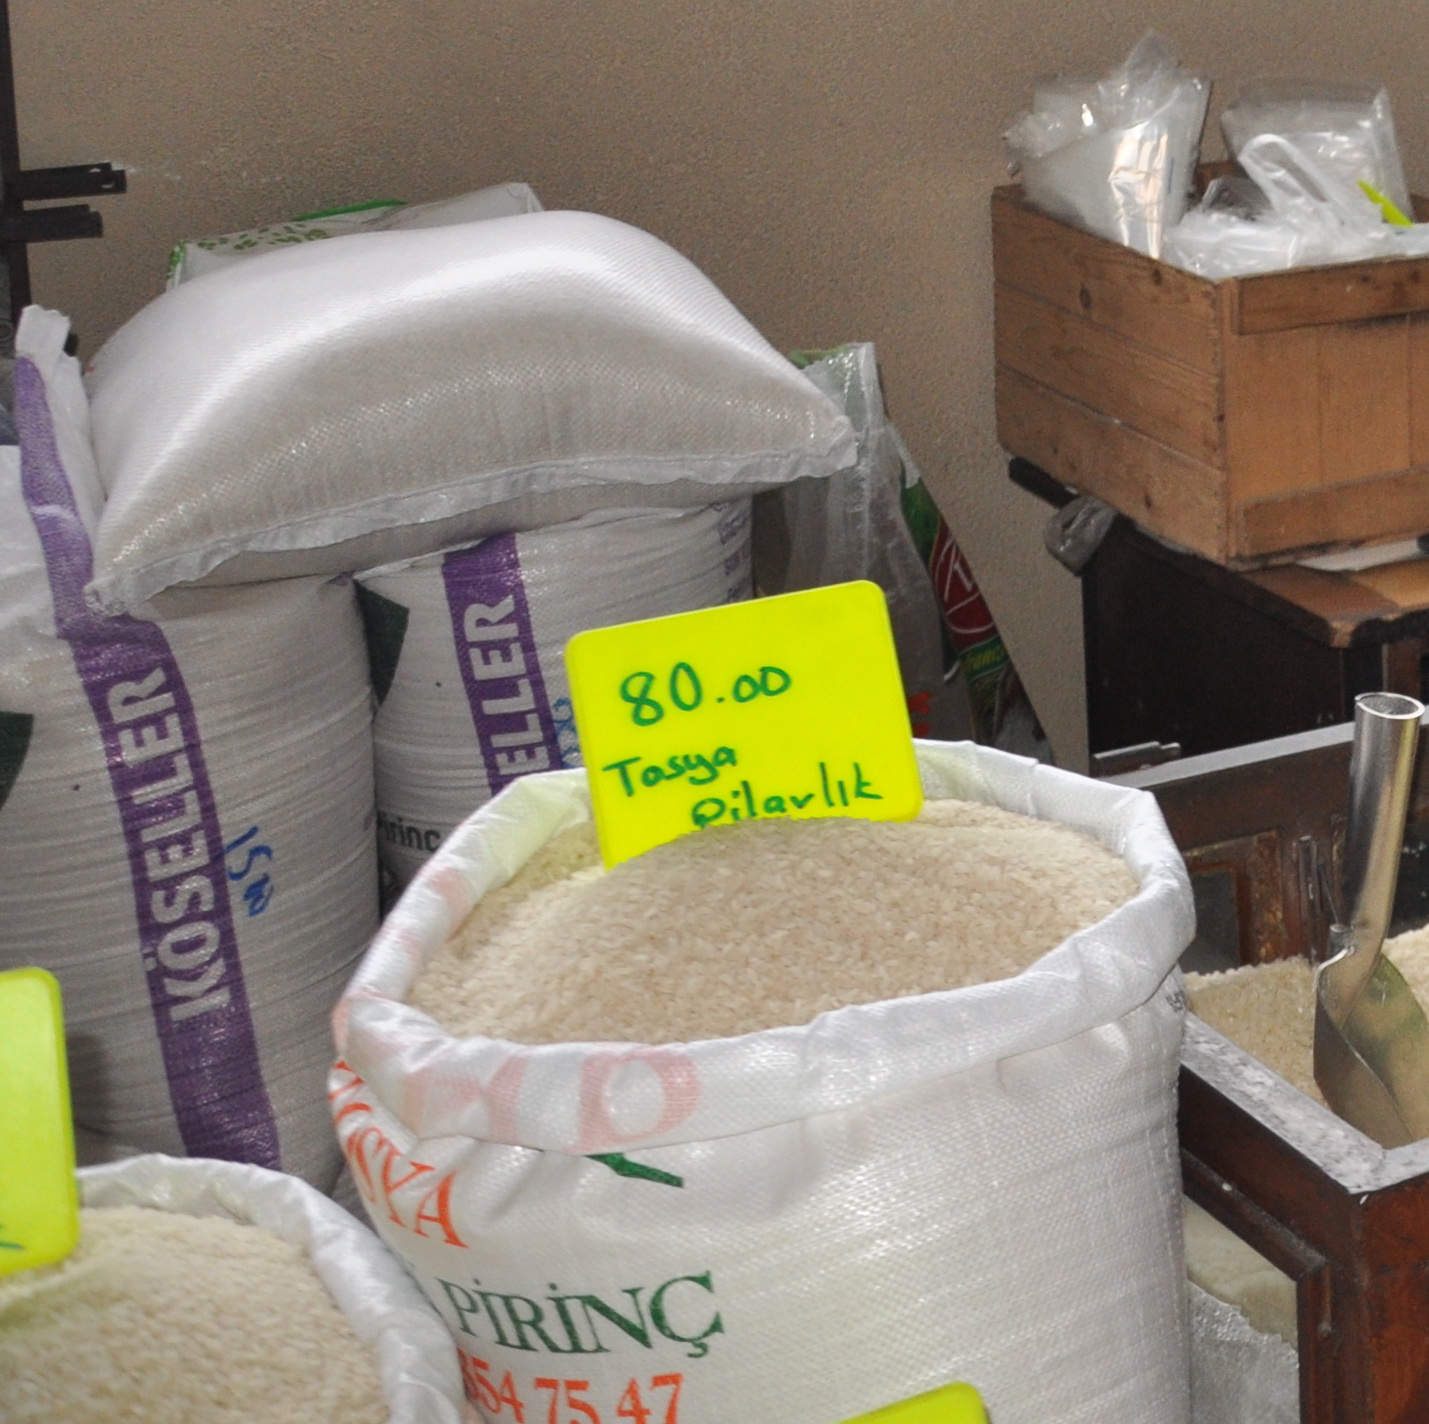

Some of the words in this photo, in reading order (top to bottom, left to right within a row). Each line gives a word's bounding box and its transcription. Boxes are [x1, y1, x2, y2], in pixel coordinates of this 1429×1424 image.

[619, 661, 793, 727] 80.00
[106, 664, 234, 1023] KÖSELLER
[437, 1269, 724, 1359] PİRİNÇ
[533, 1378, 600, 1424] 75
[616, 1372, 684, 1424] 47
